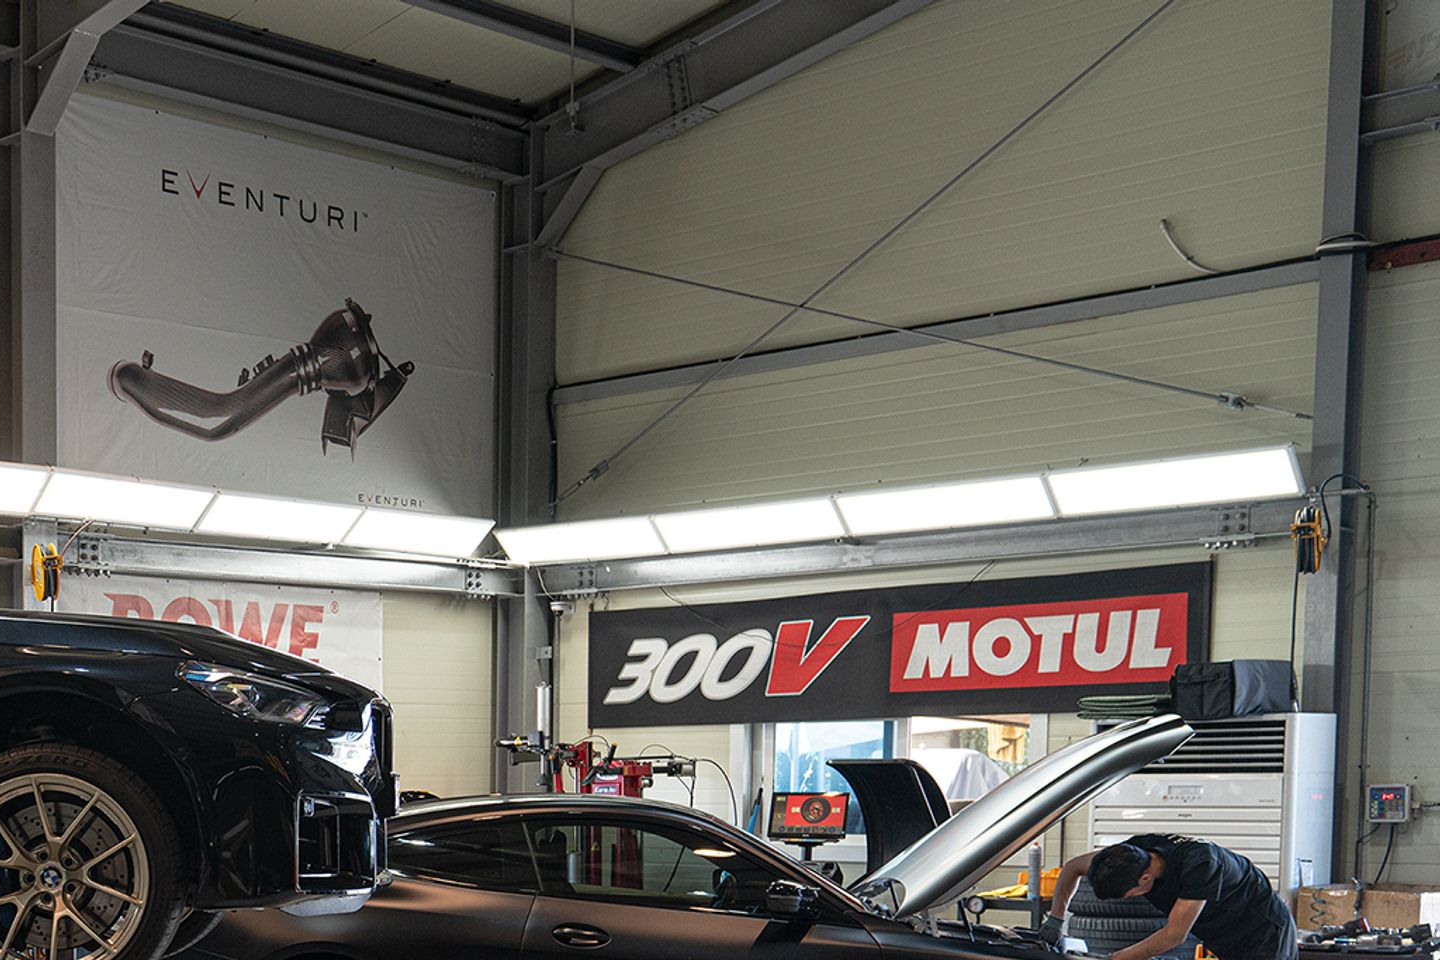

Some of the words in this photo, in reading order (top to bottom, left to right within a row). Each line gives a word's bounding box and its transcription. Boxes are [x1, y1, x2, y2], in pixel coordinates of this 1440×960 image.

[161, 168, 359, 233] EVENTURI
[358, 493, 422, 508] EVENTURI
[603, 615, 871, 705] 300V
[902, 608, 1173, 680] MOTUL
